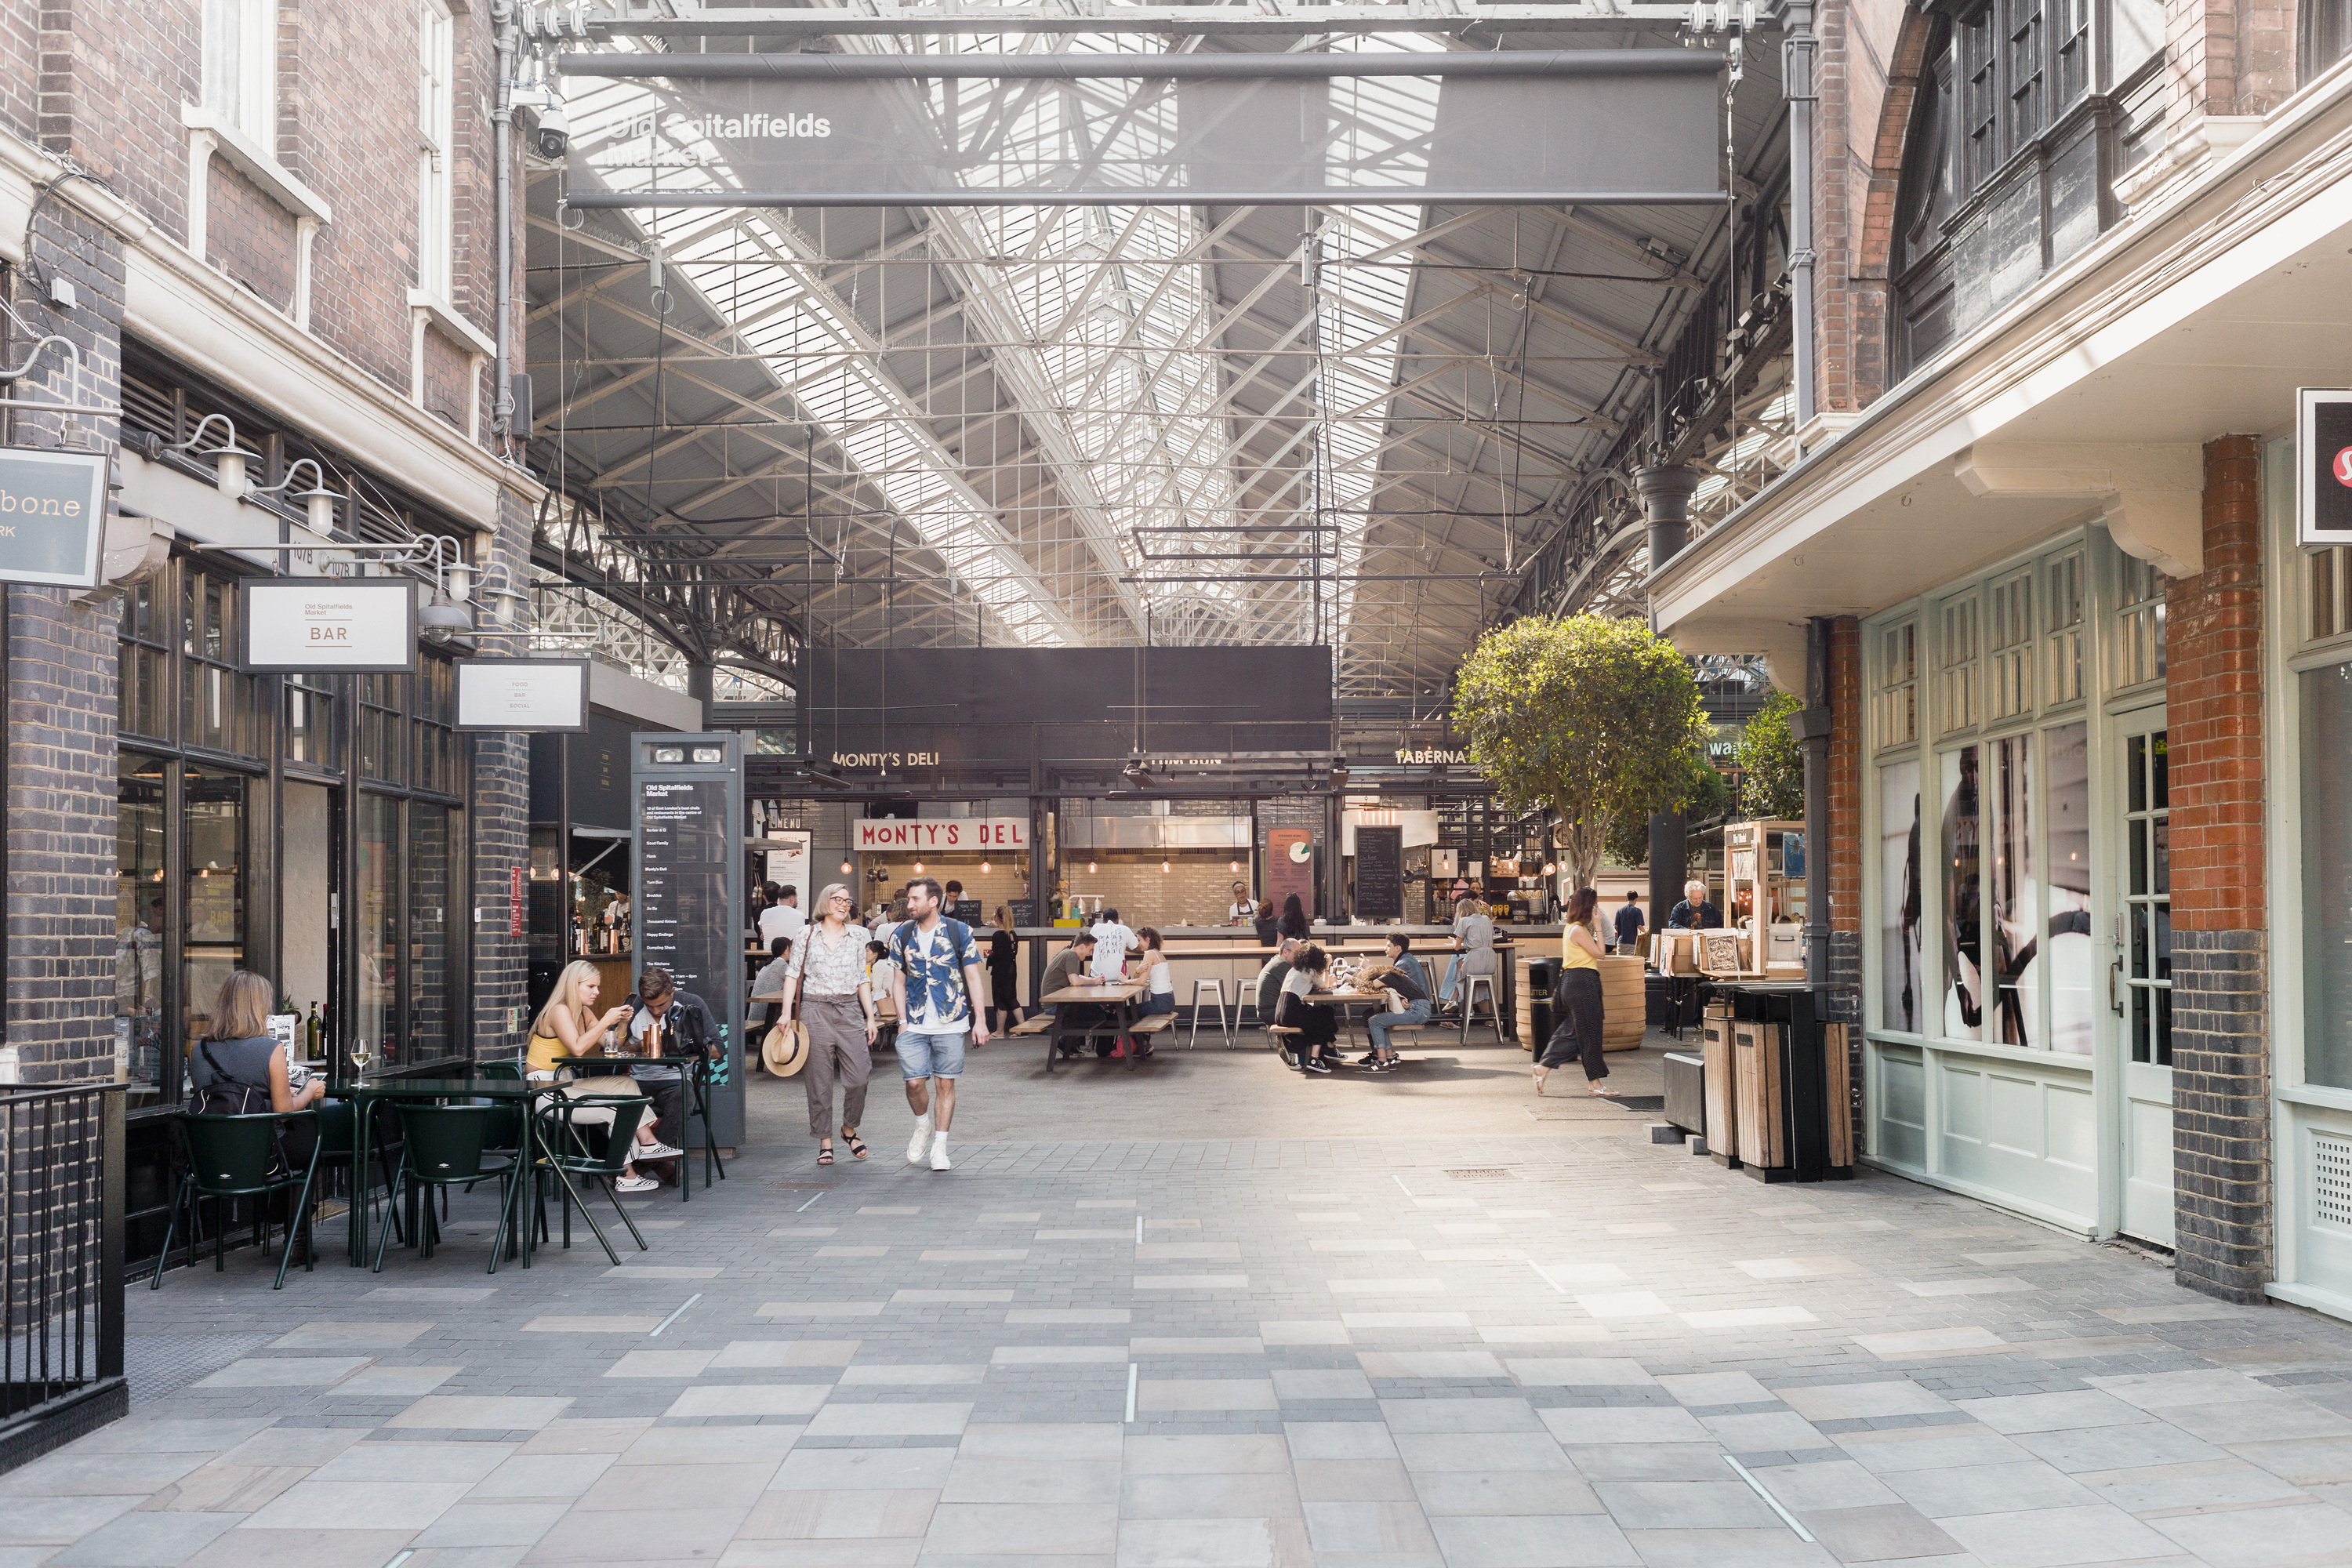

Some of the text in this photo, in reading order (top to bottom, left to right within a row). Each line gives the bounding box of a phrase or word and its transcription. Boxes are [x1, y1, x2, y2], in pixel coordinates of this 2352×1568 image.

[1, 489, 81, 517] bone
[310, 627, 347, 640] BAR
[832, 752, 938, 767] MONTY'S DELI
[1396, 750, 1467, 764] TABERNA
[778, 818, 800, 828] MENU
[862, 824, 1023, 844] MONTY'S DEL
[210, 910, 228, 926] BAR
